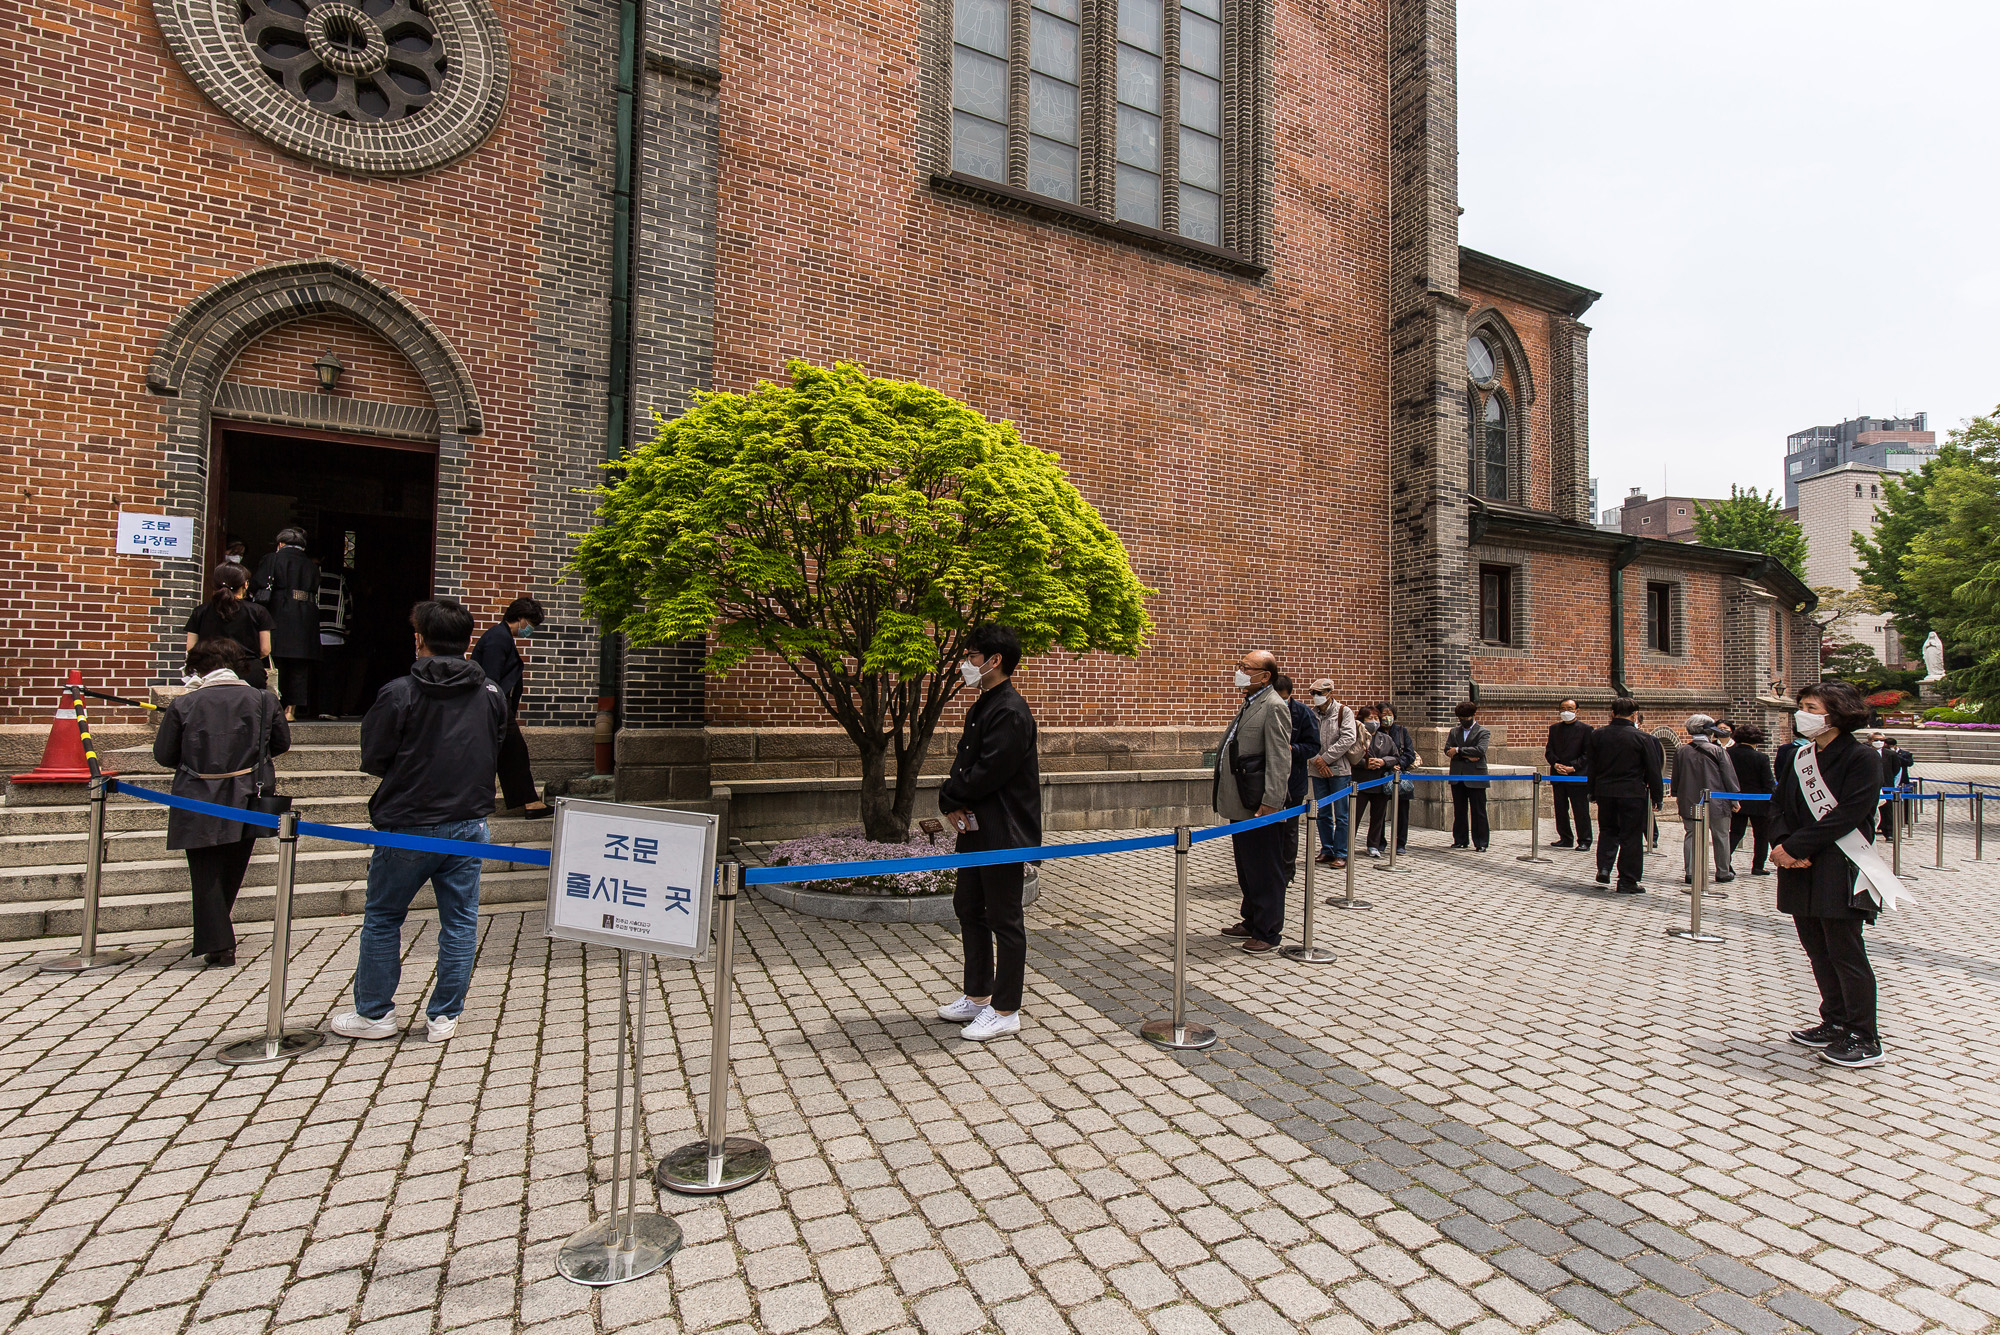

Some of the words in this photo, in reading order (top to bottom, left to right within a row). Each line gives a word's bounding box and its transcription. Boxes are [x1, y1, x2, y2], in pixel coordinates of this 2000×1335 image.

[141, 520, 171, 531] 조문
[133, 534, 178, 547] 입장문
[603, 833, 659, 864] 조문
[664, 885, 692, 915] 곳
